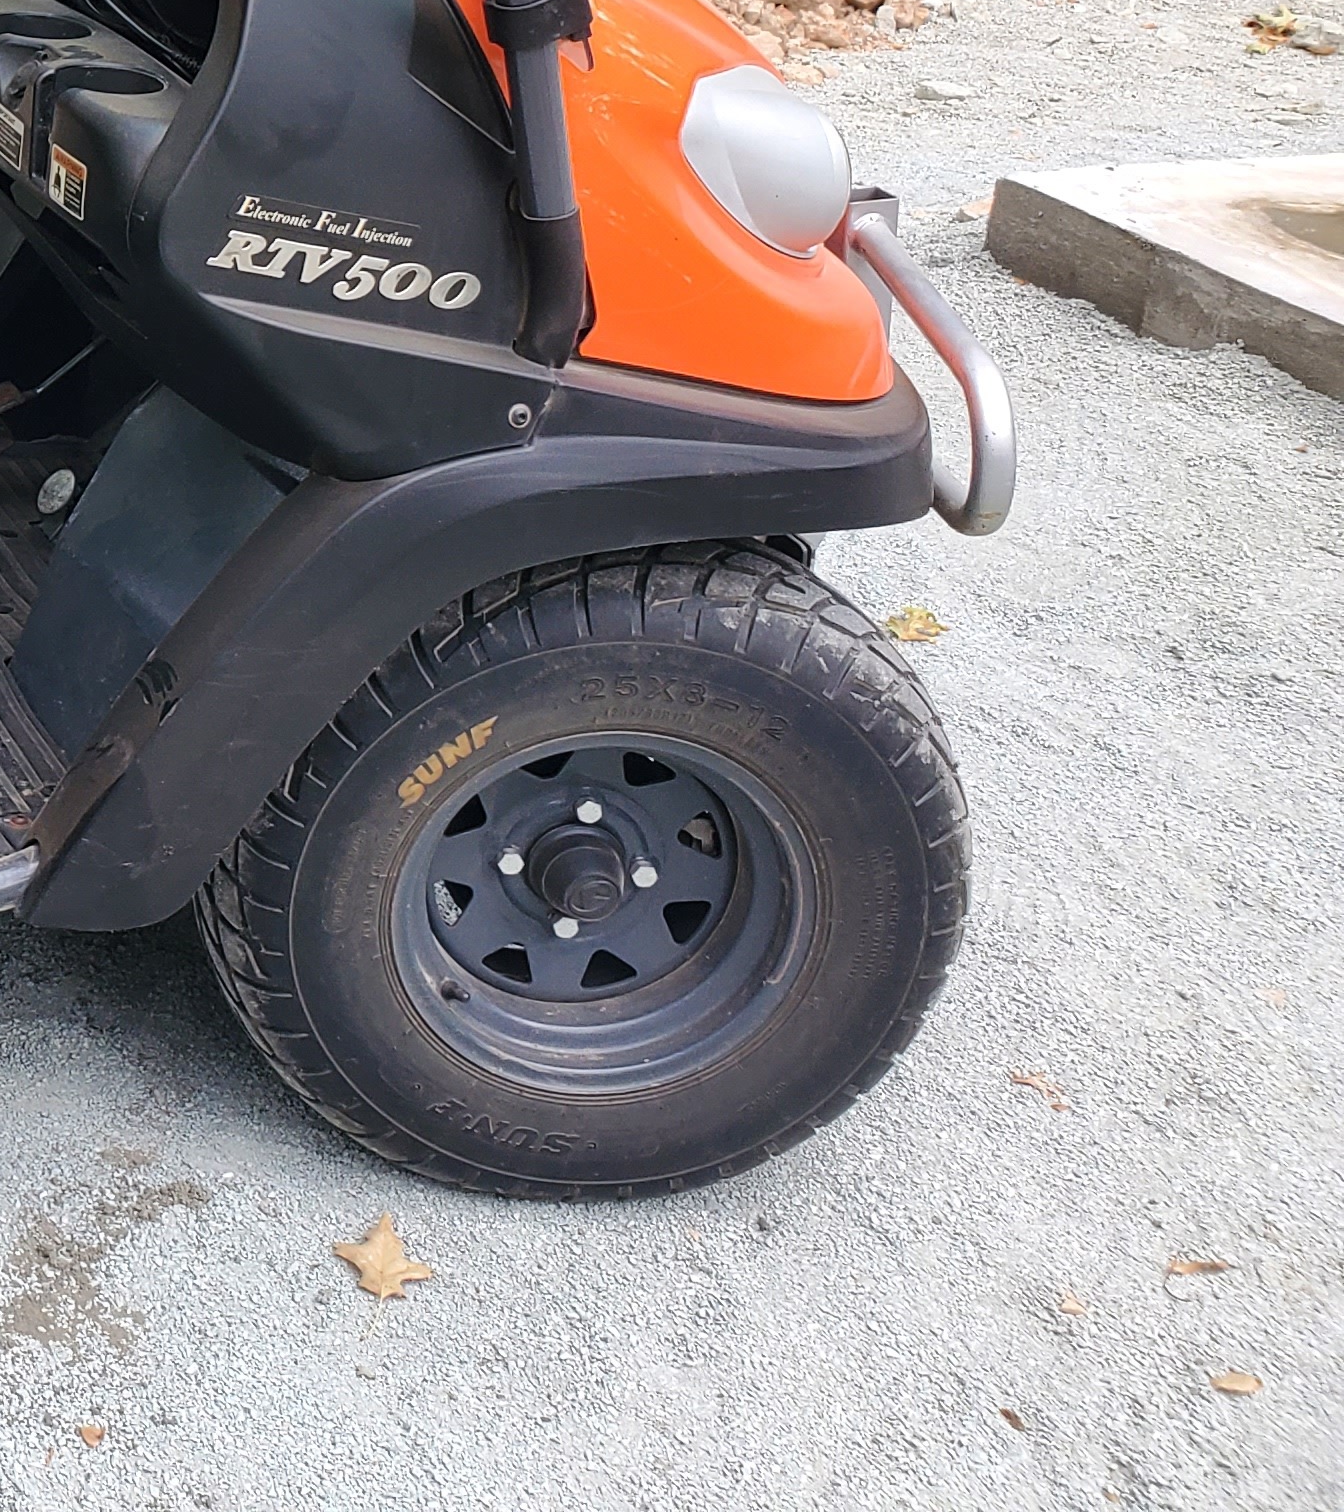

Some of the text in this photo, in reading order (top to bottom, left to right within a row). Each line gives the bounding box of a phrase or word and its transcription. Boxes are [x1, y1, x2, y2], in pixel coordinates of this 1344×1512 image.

[237, 196, 415, 248] Electronic Fuel Injection
[397, 714, 500, 807] SUNF
